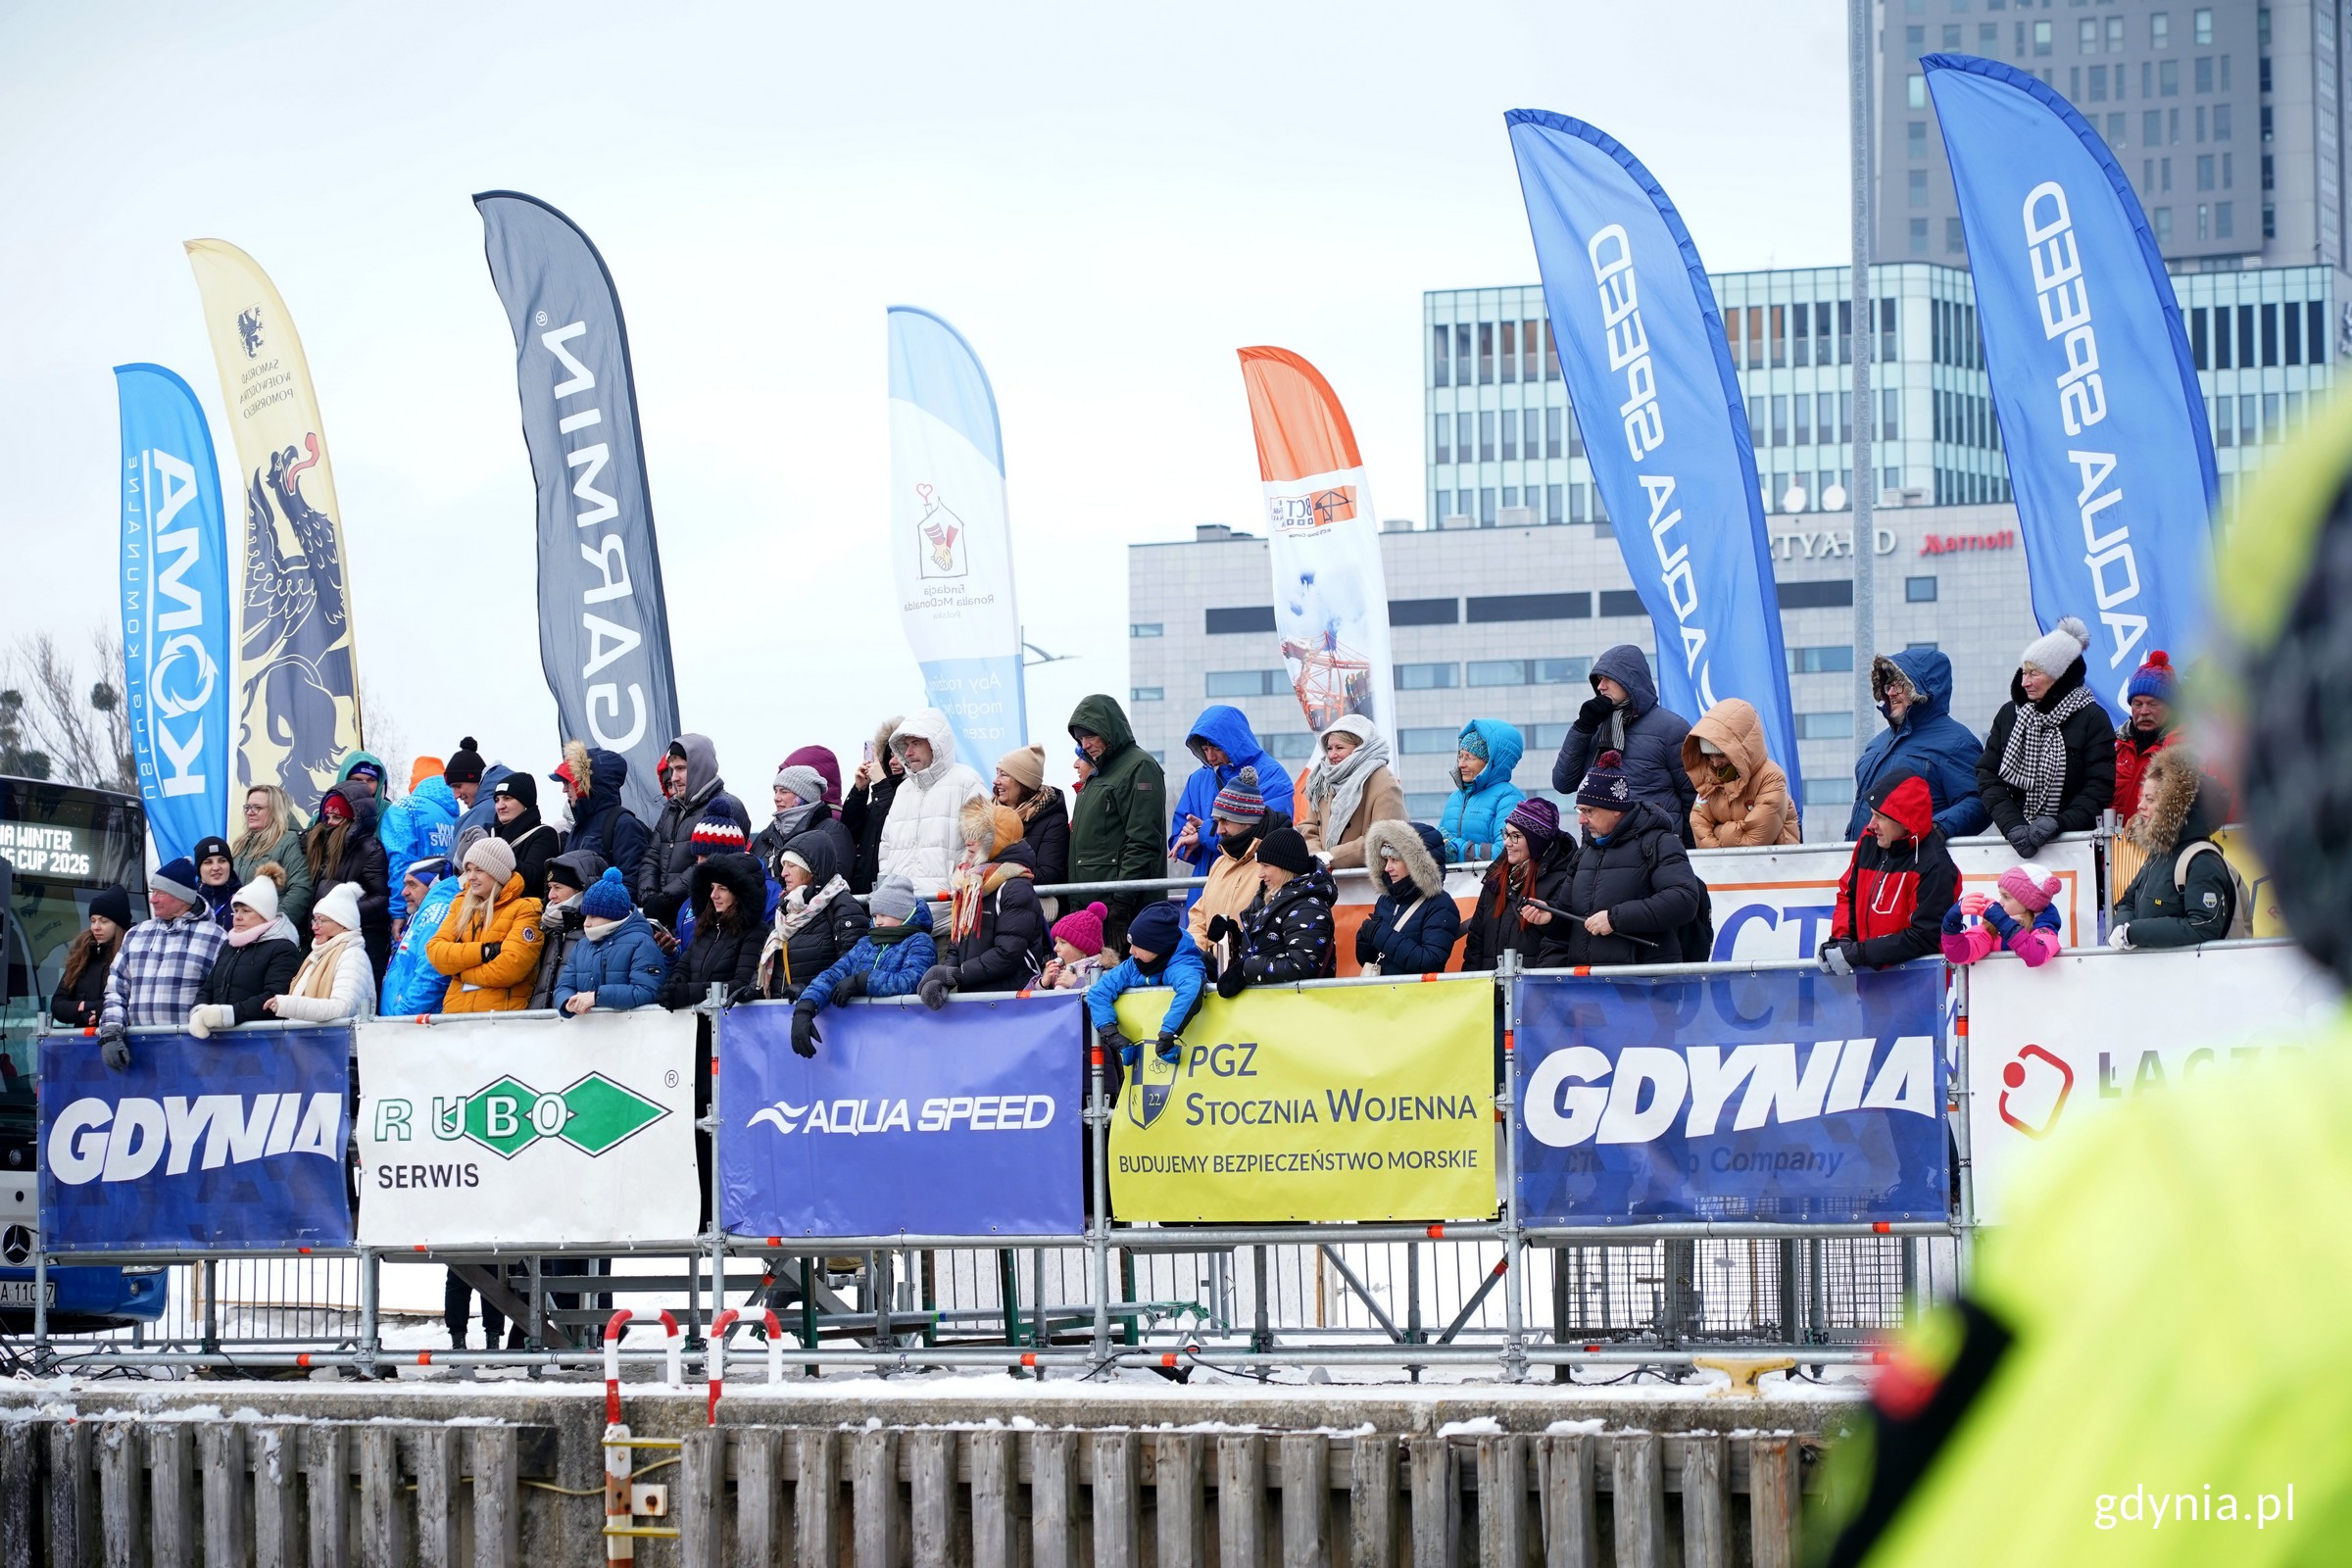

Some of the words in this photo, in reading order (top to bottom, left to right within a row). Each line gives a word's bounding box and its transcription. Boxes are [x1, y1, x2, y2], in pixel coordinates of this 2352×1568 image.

[1919, 530, 2014, 557] Marriott
[17, 826, 73, 851] WINTER
[18, 849, 48, 871] CUP
[49, 852, 90, 875] 2026
[1188, 1043, 1258, 1077] PGZ
[1524, 1036, 1936, 1148] GDYNIA
[373, 1091, 569, 1143] RUBO
[802, 1099, 911, 1137] AQUA
[917, 1095, 1056, 1132] SPEED
[47, 1092, 343, 1186] GDYNIA
[1119, 1154, 1208, 1174] BUDUJEMY
[1213, 1148, 1384, 1173] BEZPIECZEŃSTWO
[1388, 1149, 1478, 1169] MORSKIE
[377, 1162, 480, 1190] SERWIS
[15, 1283, 54, 1302] 1107
